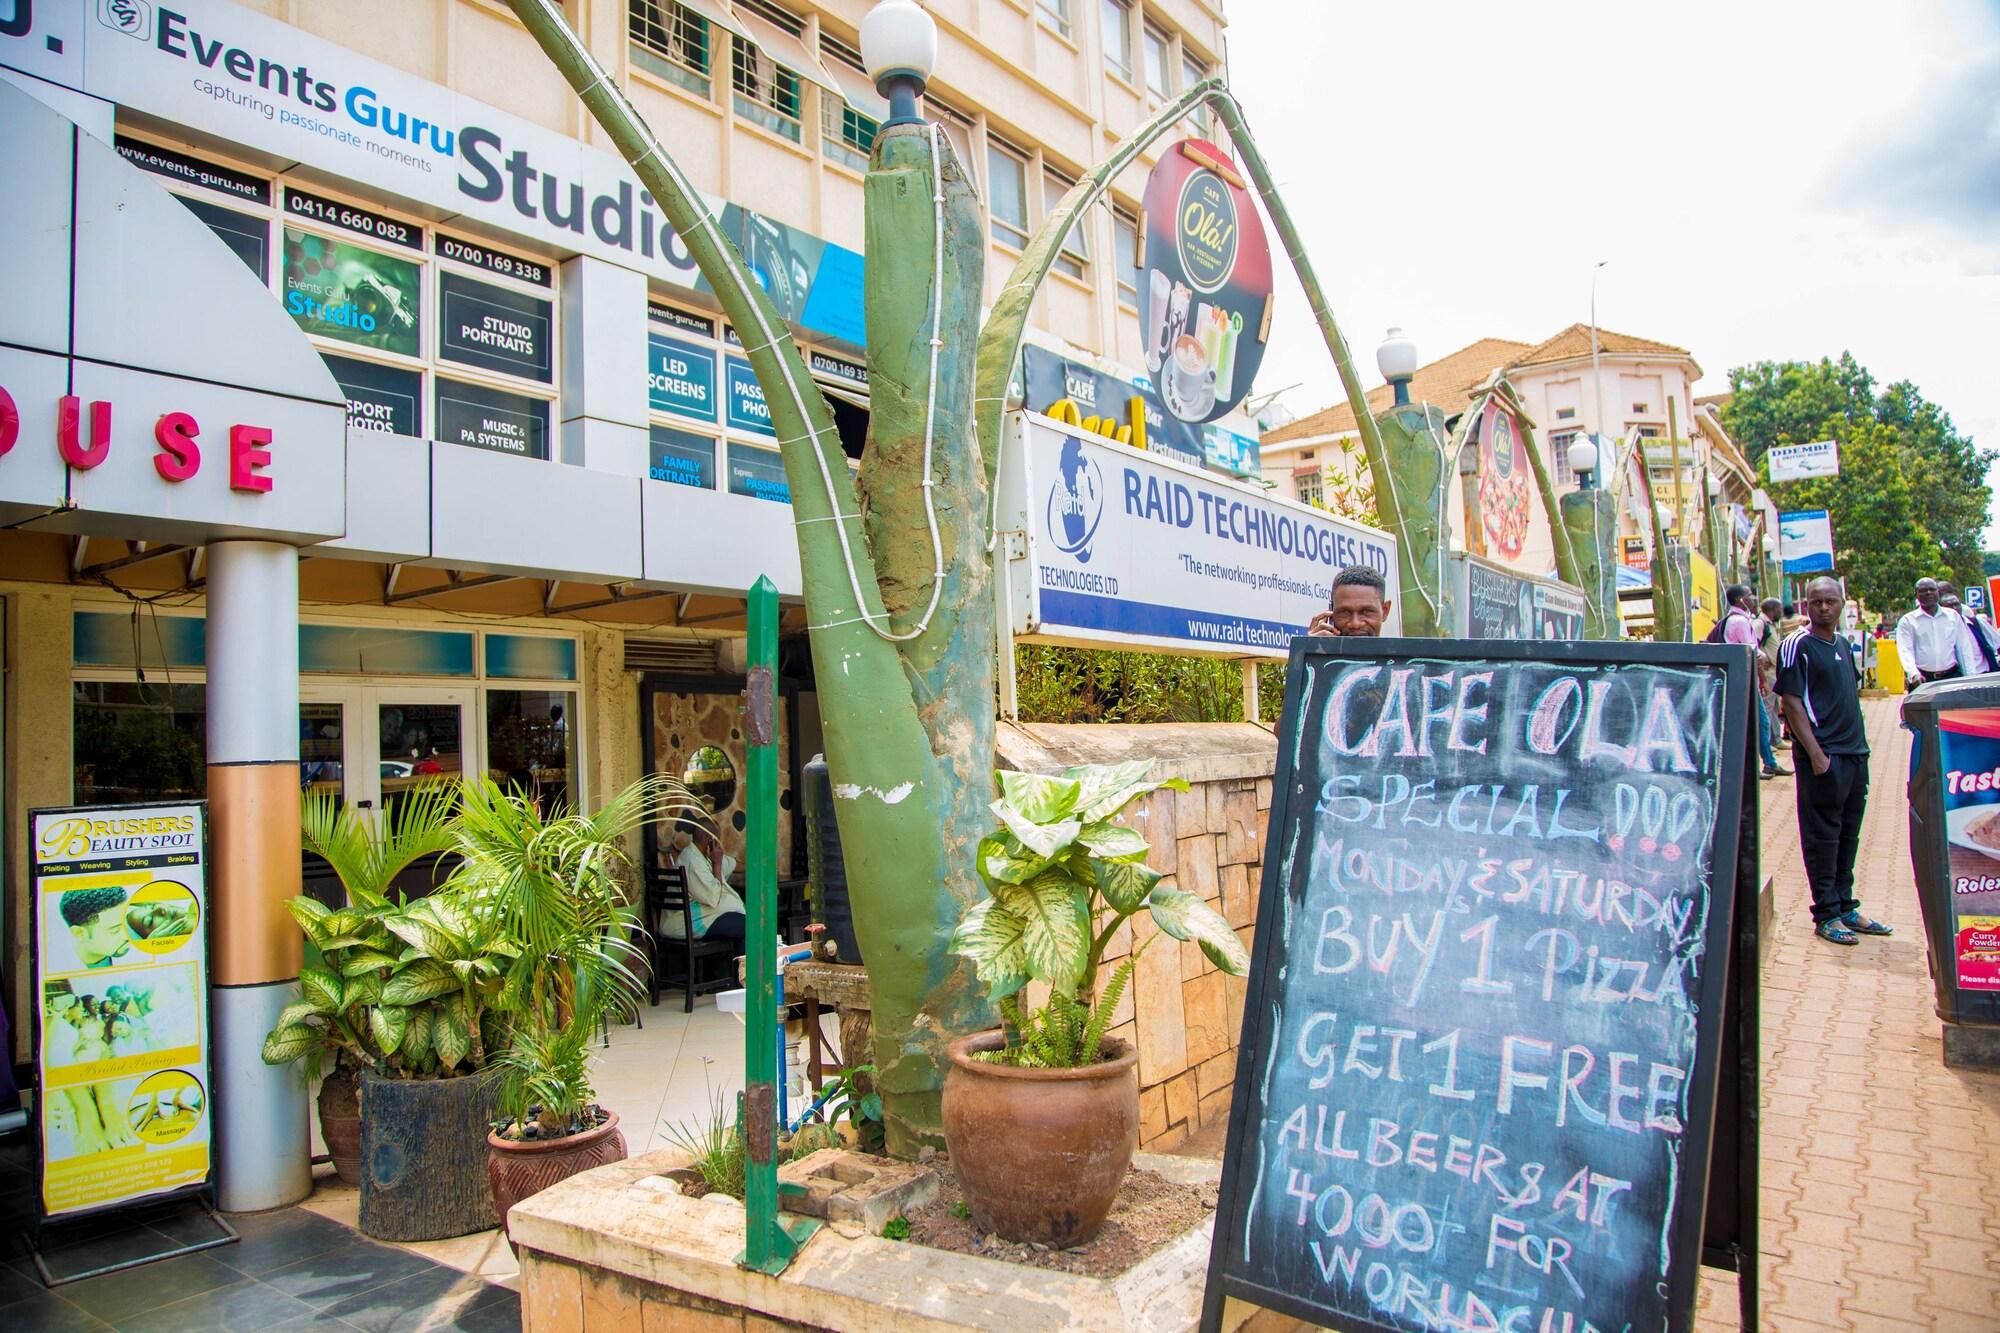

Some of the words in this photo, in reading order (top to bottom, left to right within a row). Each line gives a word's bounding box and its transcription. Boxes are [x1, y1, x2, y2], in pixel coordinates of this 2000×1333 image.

[157, 6, 337, 113] Events
[345, 86, 455, 157] Guru
[193, 77, 274, 120] capturing
[281, 108, 361, 149] passionate
[365, 140, 432, 174] moments
[458, 126, 700, 271] Studio
[291, 196, 336, 222] 0414
[342, 212, 372, 233] 660
[377, 222, 407, 242] 082
[444, 241, 482, 265] 0700
[486, 253, 512, 273] 169
[515, 261, 541, 281] 338
[288, 276, 322, 296] Events
[325, 285, 351, 303] Guru
[288, 290, 377, 333] Studio
[462, 325, 533, 355] PORTRAITS
[483, 316, 532, 340] STUDIO
[663, 357, 688, 377] LED
[815, 356, 838, 373] 0700
[839, 364, 856, 378] 169
[648, 373, 706, 400] SCREENS
[461, 429, 476, 443] PA
[478, 432, 525, 452] SYSTEMS
[483, 418, 517, 436] MUSIC
[663, 456, 701, 474] FAMILY
[1123, 467, 1194, 529] RAID
[1198, 490, 1356, 570] TECHNOLOGIES
[1040, 565, 1103, 593] TECHNOLOGIES
[1105, 576, 1119, 595] LTD
[1205, 561, 1256, 590] networking
[1968, 589, 1981, 606] P
[1188, 618, 1244, 642] www.raid
[1322, 666, 1494, 758] CAFE
[1526, 676, 1698, 773] OLA
[1315, 774, 1600, 843] SPECIAL
[151, 832, 195, 849] SPOT
[80, 860, 112, 871] Weaving
[125, 858, 149, 868] Styling
[167, 854, 195, 864] Braiding
[1972, 931, 1997, 941] Curry
[1314, 905, 1447, 1007] BUY
[1461, 914, 1513, 994] 1
[1960, 974, 1987, 984] Please
[1298, 1012, 1417, 1089] GET
[1422, 1029, 1475, 1100] 1
[1497, 1034, 1686, 1134] FREE
[155, 1126, 187, 1138] Massage
[1277, 1104, 1360, 1160] ALL
[1553, 1165, 1633, 1228] AT
[1486, 1213, 1586, 1300] FOR
